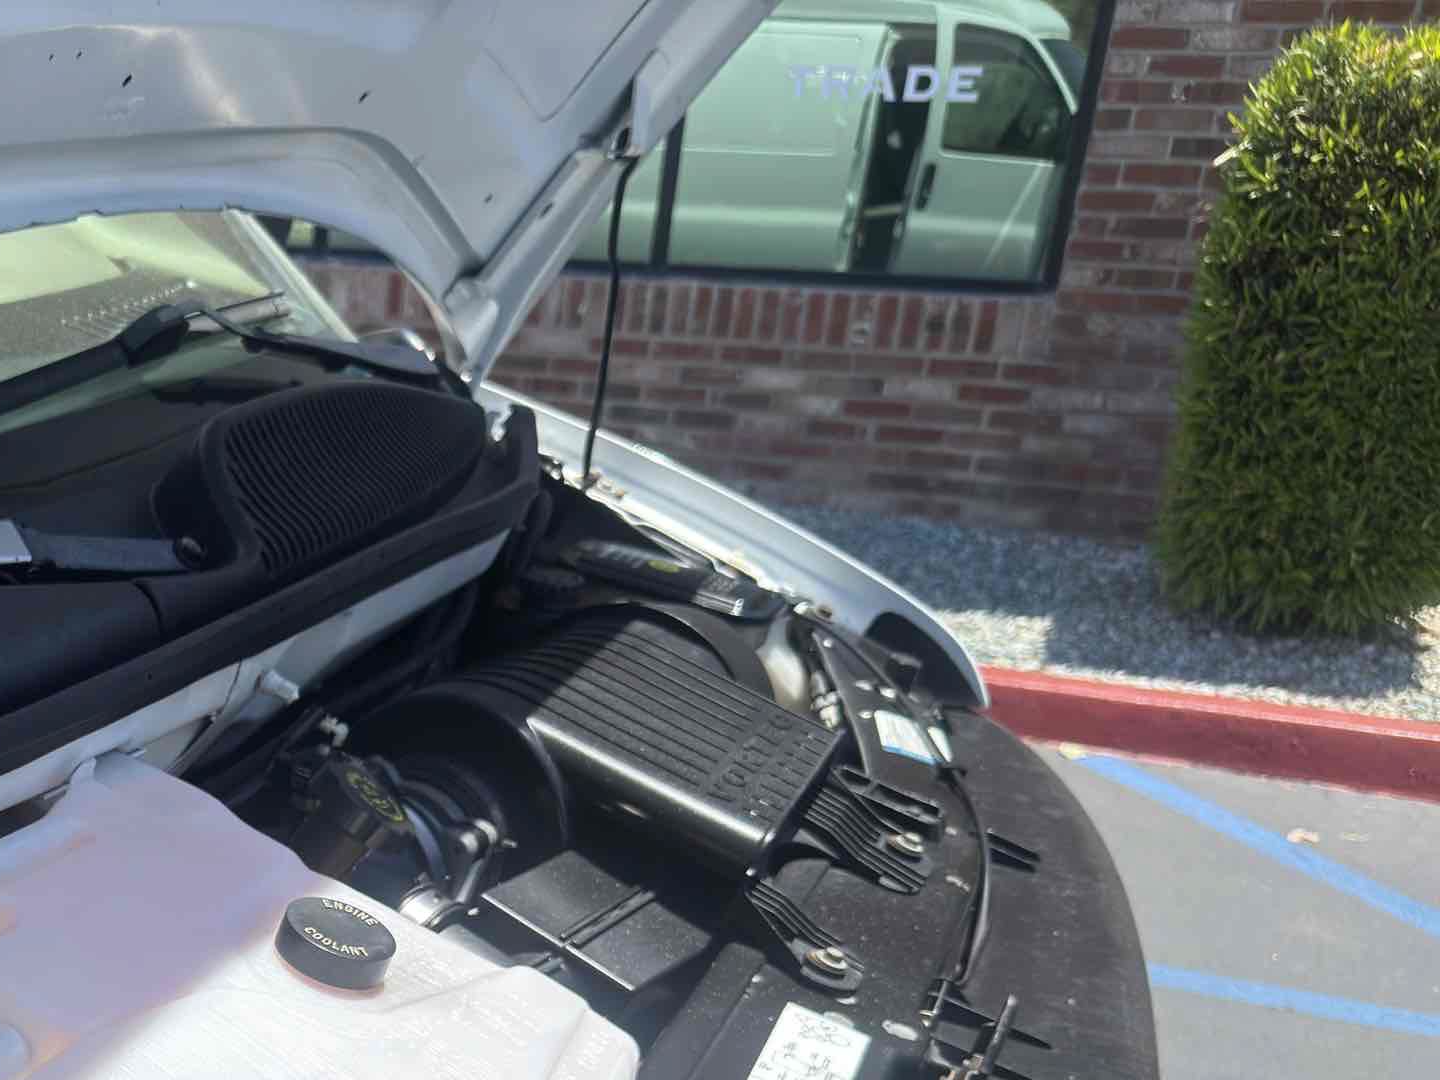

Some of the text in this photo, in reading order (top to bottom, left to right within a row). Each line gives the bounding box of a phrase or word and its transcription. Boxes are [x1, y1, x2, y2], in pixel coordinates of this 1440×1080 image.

[788, 64, 983, 102] TRADE
[321, 898, 378, 928] ENGINE
[304, 926, 369, 958] COOLANT
